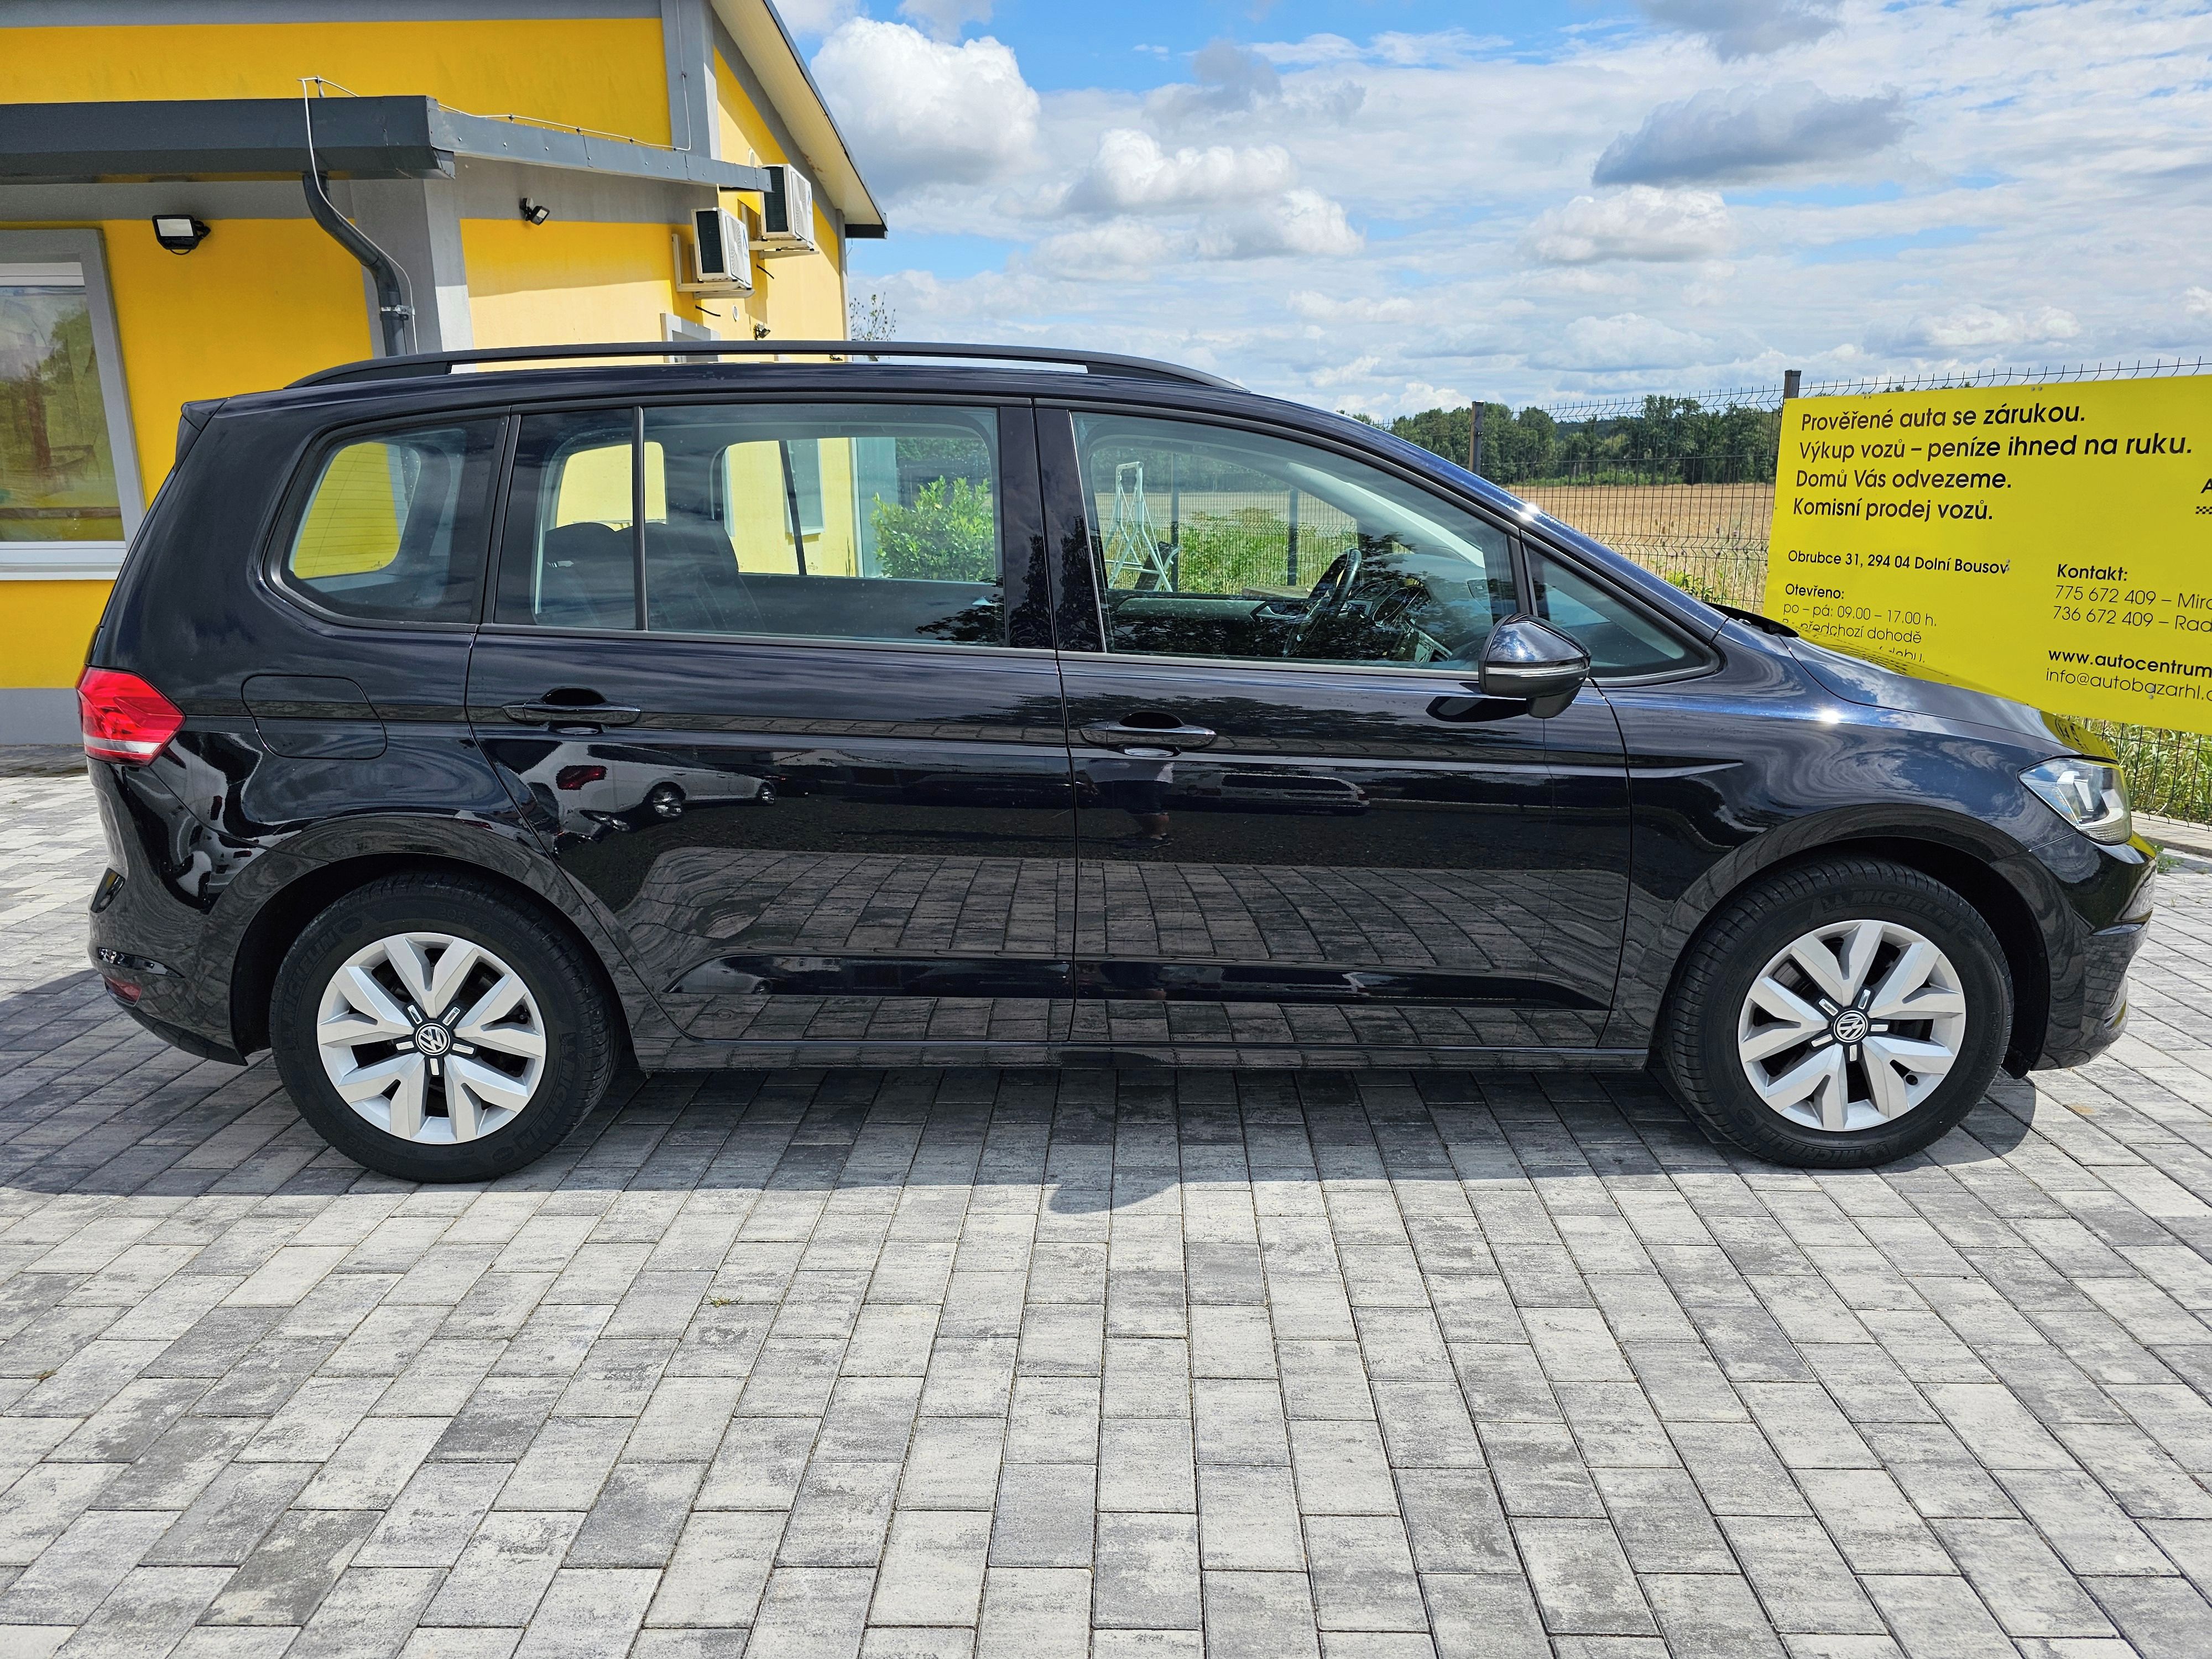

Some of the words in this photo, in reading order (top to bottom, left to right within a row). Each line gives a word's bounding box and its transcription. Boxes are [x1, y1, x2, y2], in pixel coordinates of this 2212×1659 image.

[1801, 408, 1893, 431] Prověřené
[1900, 408, 1947, 428] auta
[1952, 410, 1976, 426] se
[1983, 402, 2085, 425] zárukou.
[1799, 440, 1855, 463] Výkup
[1861, 439, 1905, 458] vozů
[1927, 436, 2001, 462] peníze
[2008, 434, 2078, 456] ihned
[2084, 438, 2118, 455] na
[2125, 432, 2192, 455] ruku.
[1796, 469, 1848, 488] Domů
[1854, 468, 1886, 488] Vás
[1892, 469, 2011, 489] odvezeme.
[1793, 497, 1863, 517] Komisní
[1865, 499, 1931, 523] prodej
[1937, 499, 1992, 520] vozů.
[1788, 550, 1841, 565] Obrubce
[1845, 552, 1863, 568] 31,
[1867, 554, 1891, 567] 294
[1895, 555, 1910, 568] 04
[1914, 556, 1952, 571] Dolní
[1954, 558, 2008, 574] Bousov
[2057, 564, 2128, 581] Kontakt:
[1785, 583, 1844, 599] Otevřeno:
[2056, 585, 2083, 601] 775
[2089, 587, 2119, 603] 672
[2124, 589, 2156, 606] 409
[1783, 603, 1799, 615] po
[1812, 604, 1833, 618] pá:
[1837, 606, 1871, 620] 09.00
[1888, 609, 1921, 625] 17.00
[1925, 613, 1937, 627] h.
[2053, 606, 2081, 621] 736
[2086, 608, 2116, 624] 672
[2121, 611, 2153, 627] 409
[1867, 627, 1922, 644] dohodě
[2048, 650, 2212, 678] www.autocentrum
